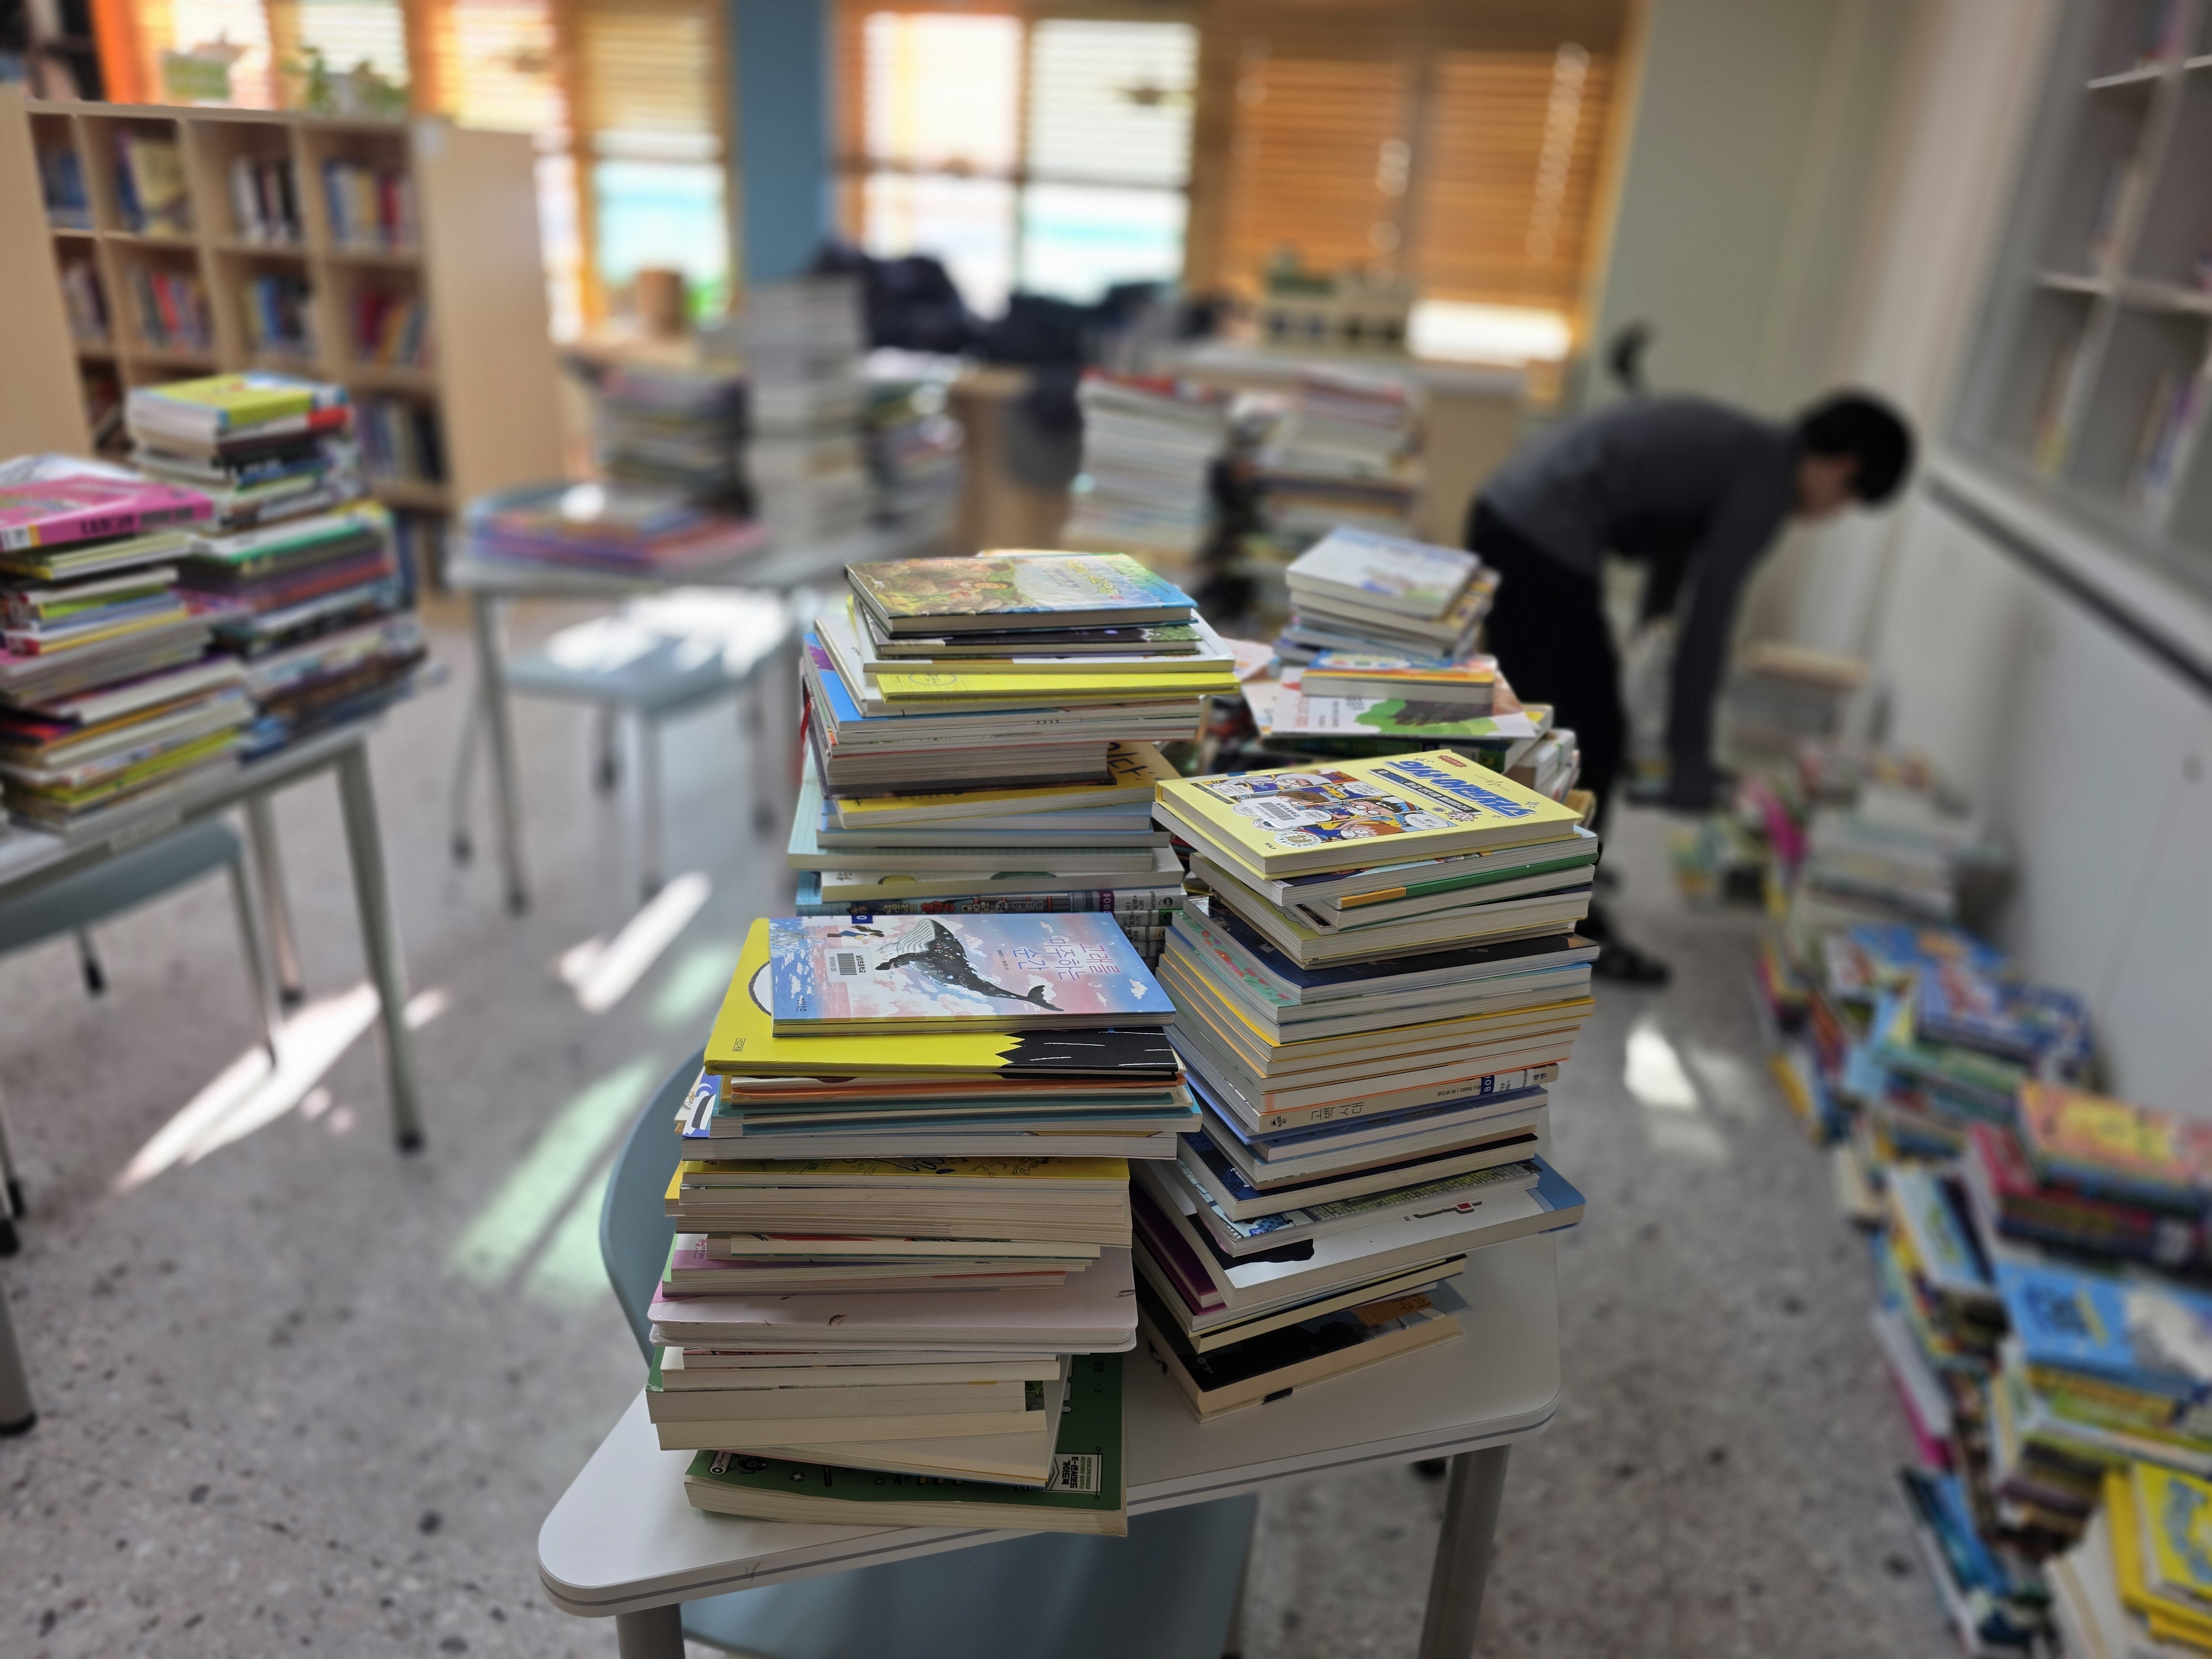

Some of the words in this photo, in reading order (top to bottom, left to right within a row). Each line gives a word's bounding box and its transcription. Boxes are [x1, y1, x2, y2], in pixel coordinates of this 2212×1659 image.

[1385, 761, 1452, 779] 의사
[1430, 779, 1536, 818] 어벤저스
[1418, 787, 1442, 797] 센터를
[884, 903, 917, 914] 설민석의
[920, 901, 956, 914] 한국사
[961, 901, 990, 913] 대모험
[998, 902, 1005, 911] 26
[1012, 901, 1034, 910] 박병선
[1036, 901, 1044, 910] 편
[855, 954, 866, 973] 남양초등학교
[1013, 948, 1050, 970] 순간
[1044, 938, 1086, 981] 마주하는
[1079, 943, 1120, 974] 고래를
[1311, 1107, 1335, 1120] 고백
[1339, 1102, 1364, 1116] 시대
[1061, 1460, 1071, 1485] 가이드북
[1070, 1456, 1079, 1489] E-센서보드
